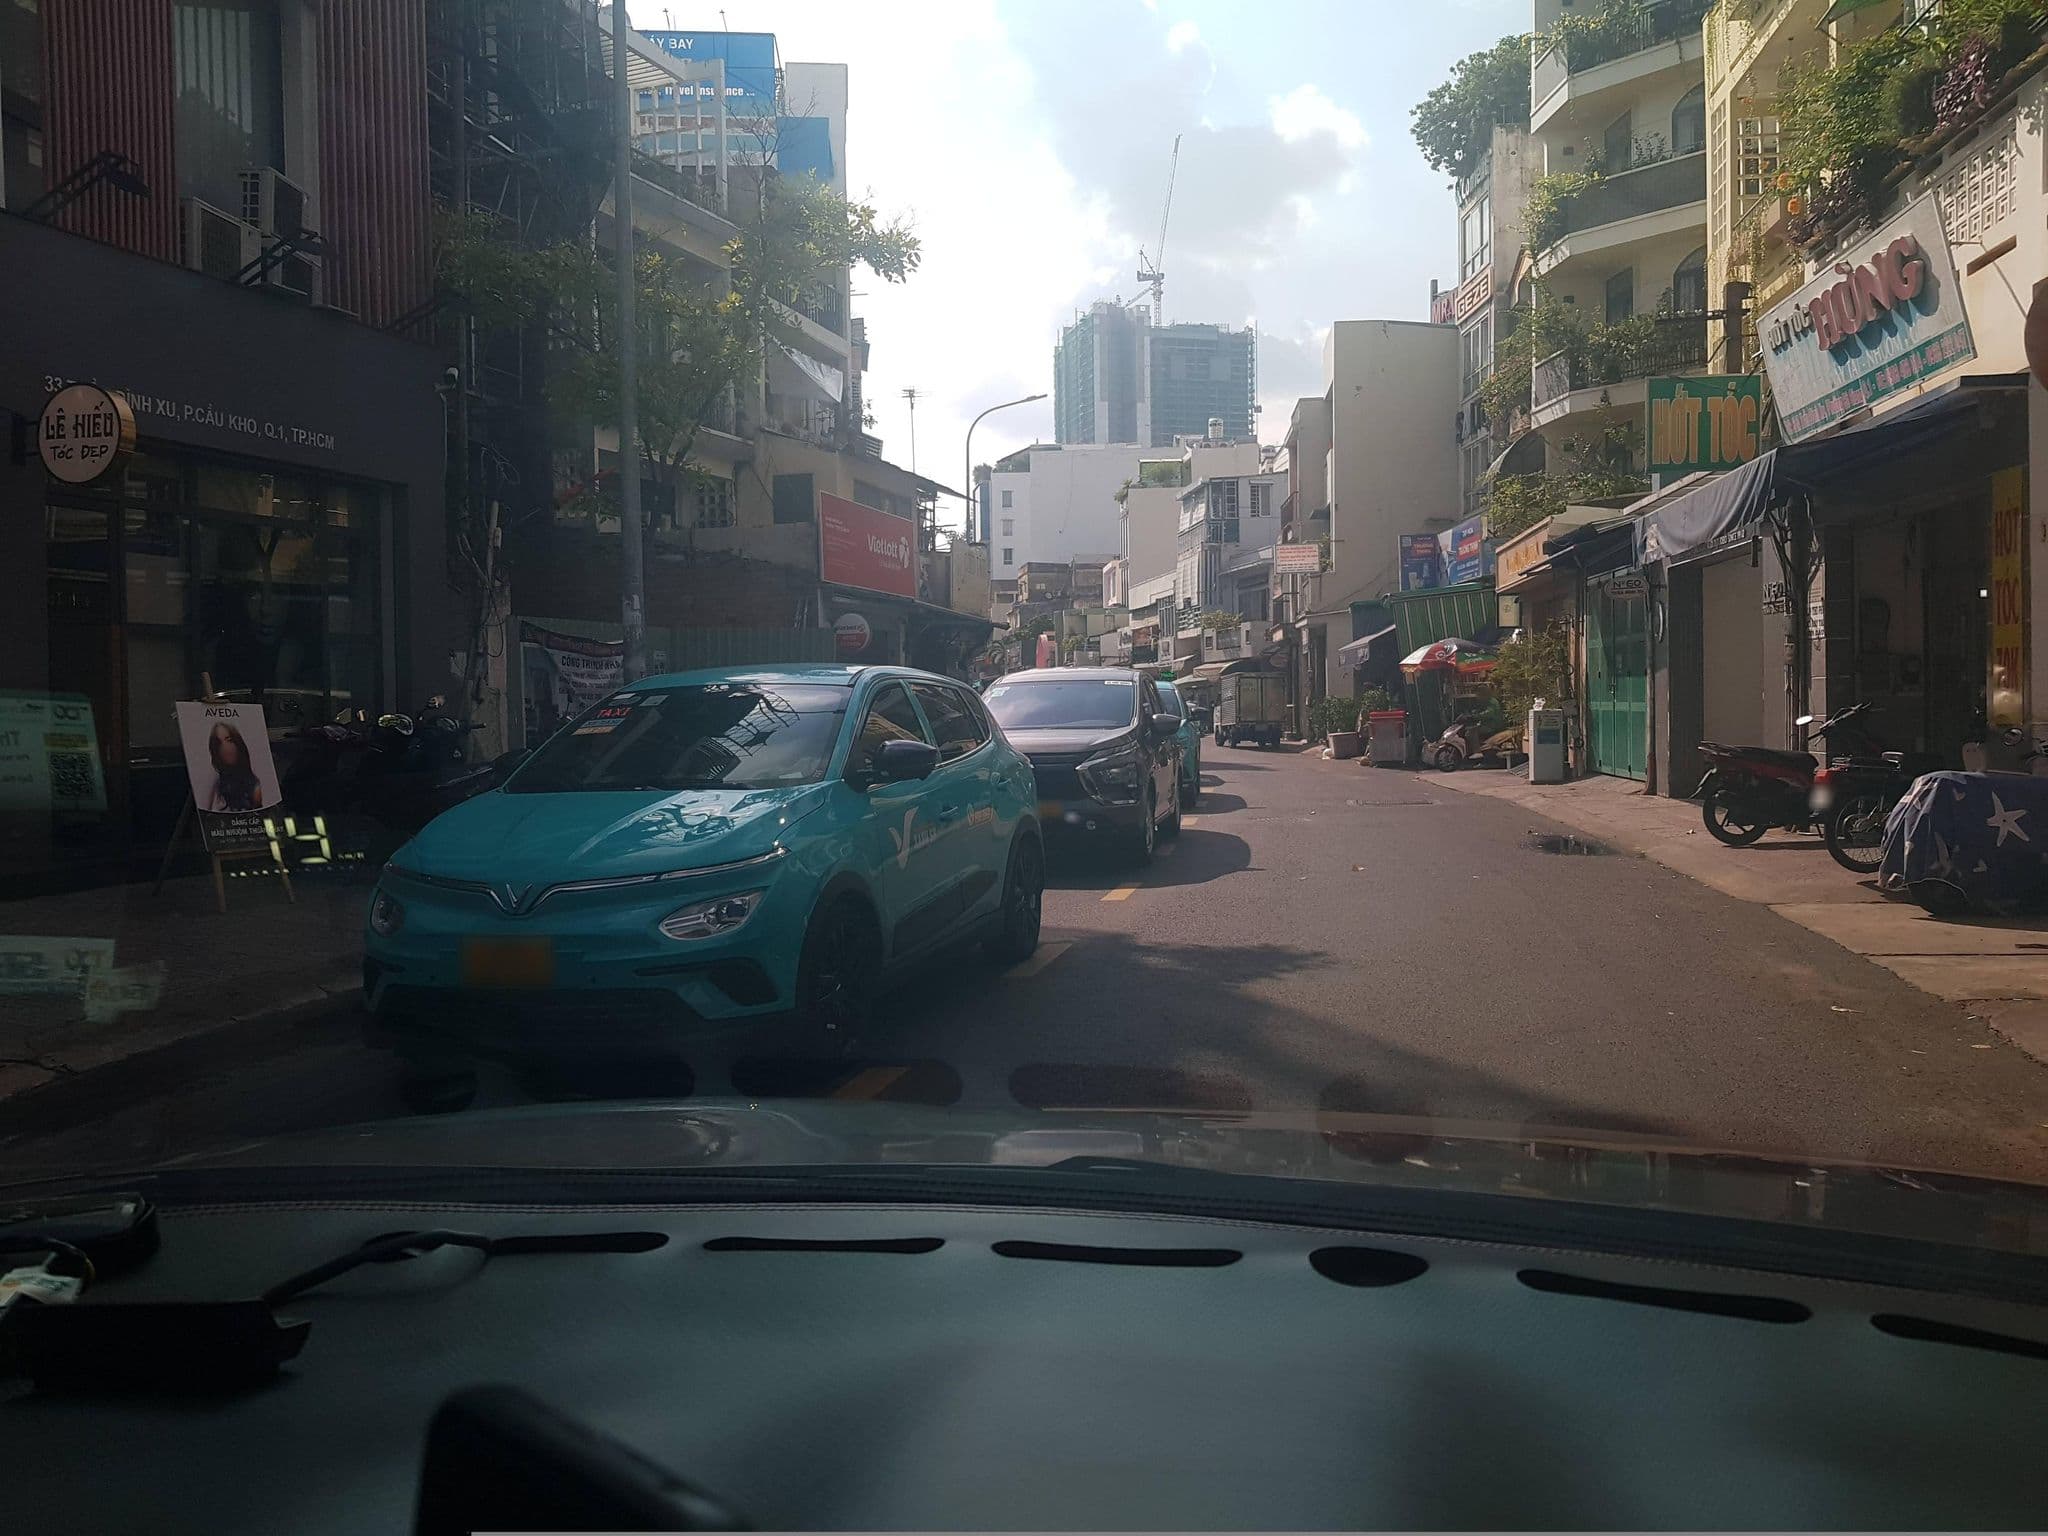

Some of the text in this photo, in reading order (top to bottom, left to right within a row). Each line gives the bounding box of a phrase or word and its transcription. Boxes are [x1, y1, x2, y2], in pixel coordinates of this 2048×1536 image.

[668, 38, 694, 49] BAY
[1457, 276, 1489, 318] GEZE
[46, 401, 113, 440] LÊ HIẾU
[228, 414, 262, 438] KHO,
[291, 427, 335, 450] TP.HCM
[1652, 383, 1702, 464] HỚT
[1707, 382, 1756, 463] TÓC
[81, 444, 109, 463] ĐẸP
[867, 533, 898, 559] Vietlott
[204, 708, 240, 718] AVEDA
